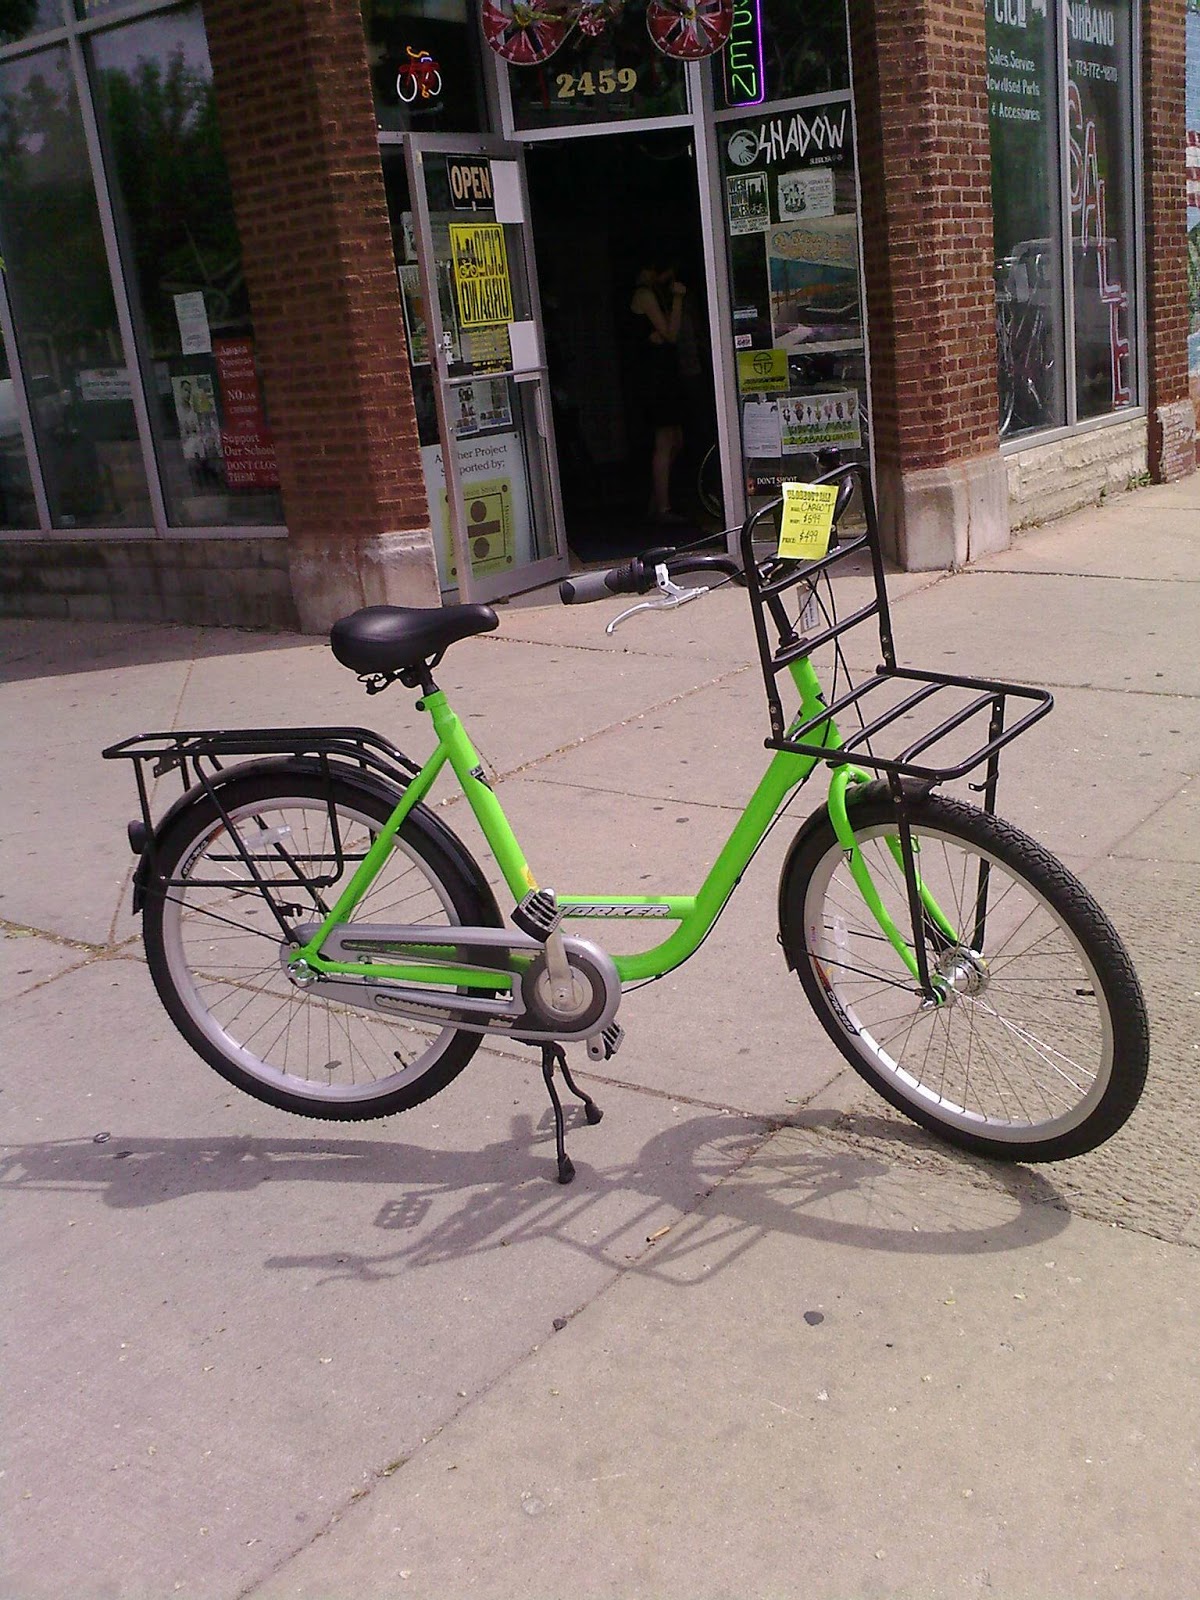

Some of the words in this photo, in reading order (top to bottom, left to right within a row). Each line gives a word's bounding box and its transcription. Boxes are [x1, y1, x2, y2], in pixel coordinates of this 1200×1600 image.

[1071, 3, 1114, 46] URBANO
[730, 0, 756, 97] PEN
[556, 67, 637, 98] 2459
[999, 102, 1040, 121] Accessories
[758, 109, 846, 164] SHADOW
[451, 165, 492, 199] OPEN
[227, 390, 242, 401] NO
[222, 433, 260, 445] Support
[224, 445, 242, 456] Our
[475, 444, 508, 459] Project
[227, 461, 254, 470] DON'T
[255, 460, 277, 470] CLOS
[799, 530, 819, 543] $499
